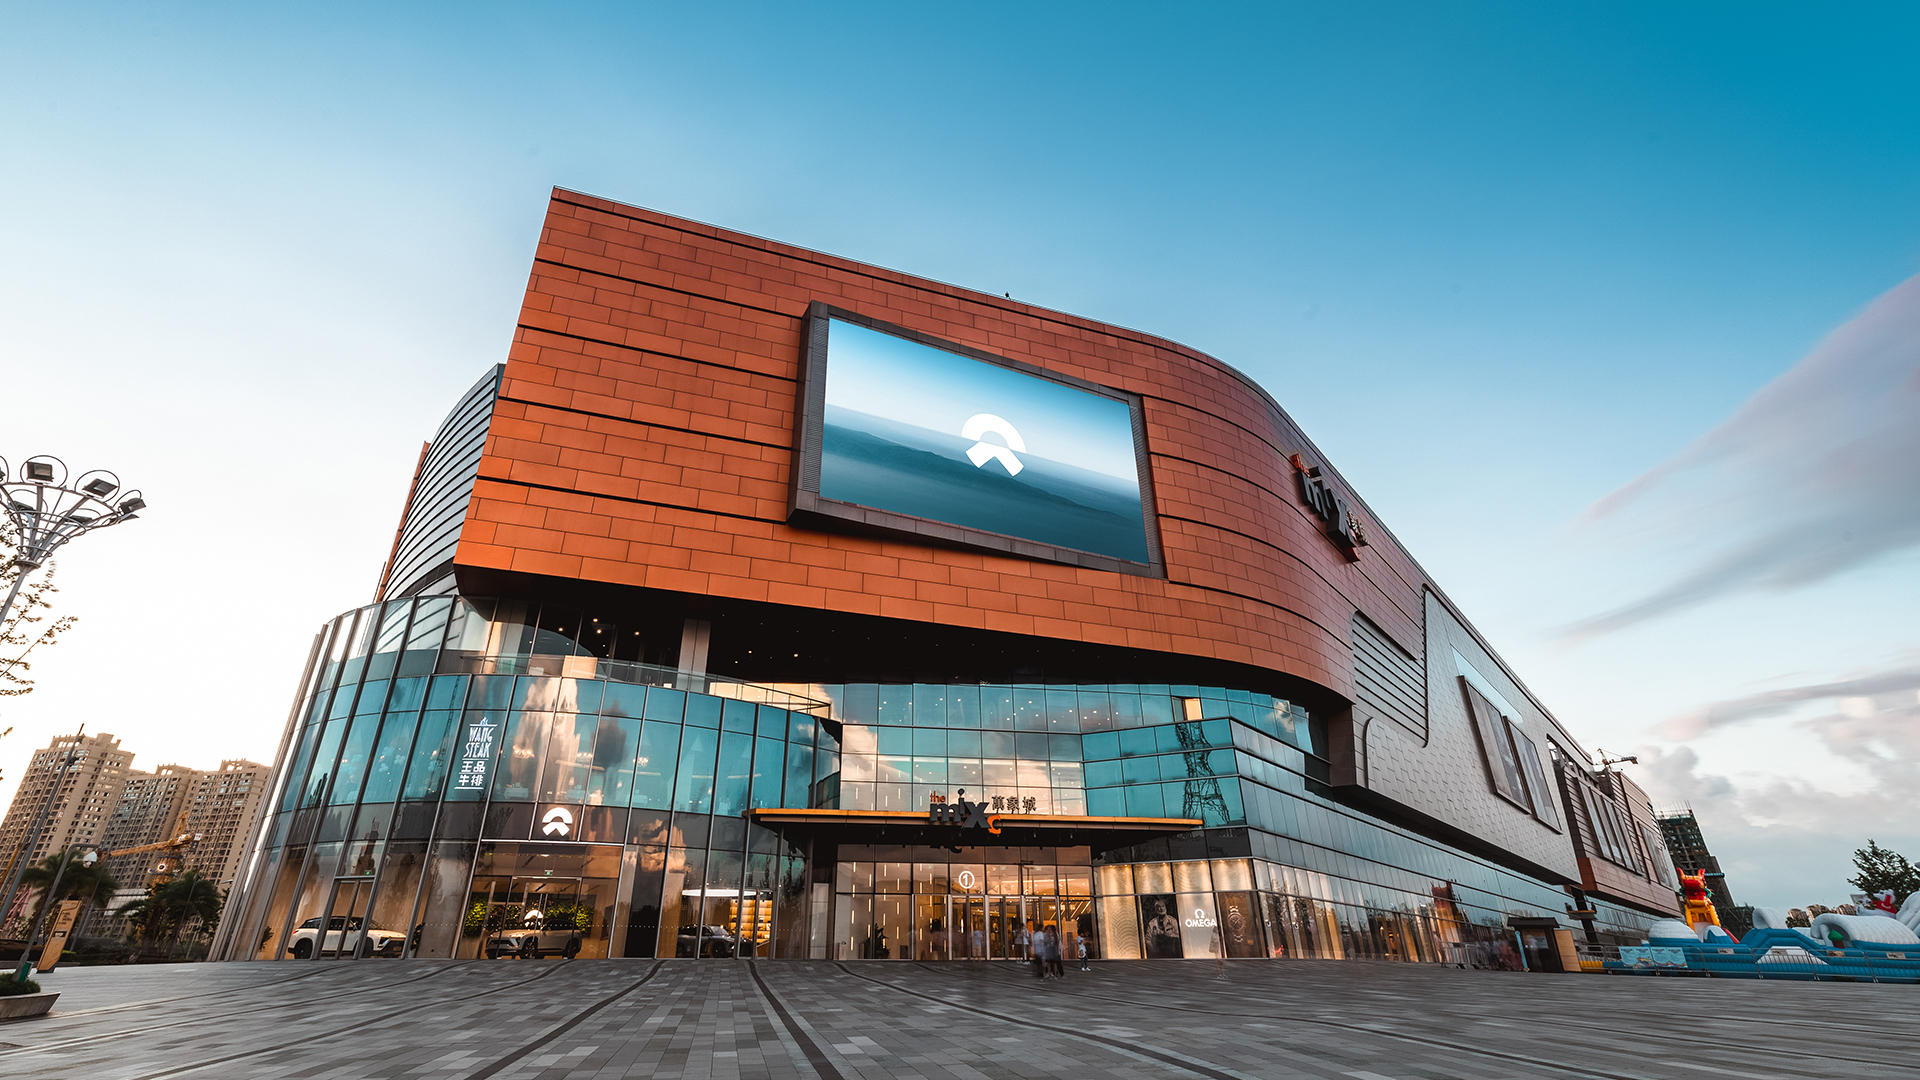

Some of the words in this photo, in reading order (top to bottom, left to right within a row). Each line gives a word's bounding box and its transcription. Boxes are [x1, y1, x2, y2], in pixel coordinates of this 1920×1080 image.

[469, 727, 494, 742] WANG
[463, 742, 492, 758] STEAK
[461, 761, 486, 773] 王品
[458, 774, 484, 786] 牛排
[930, 791, 946, 803] the
[1185, 918, 1218, 928] OMEGA
